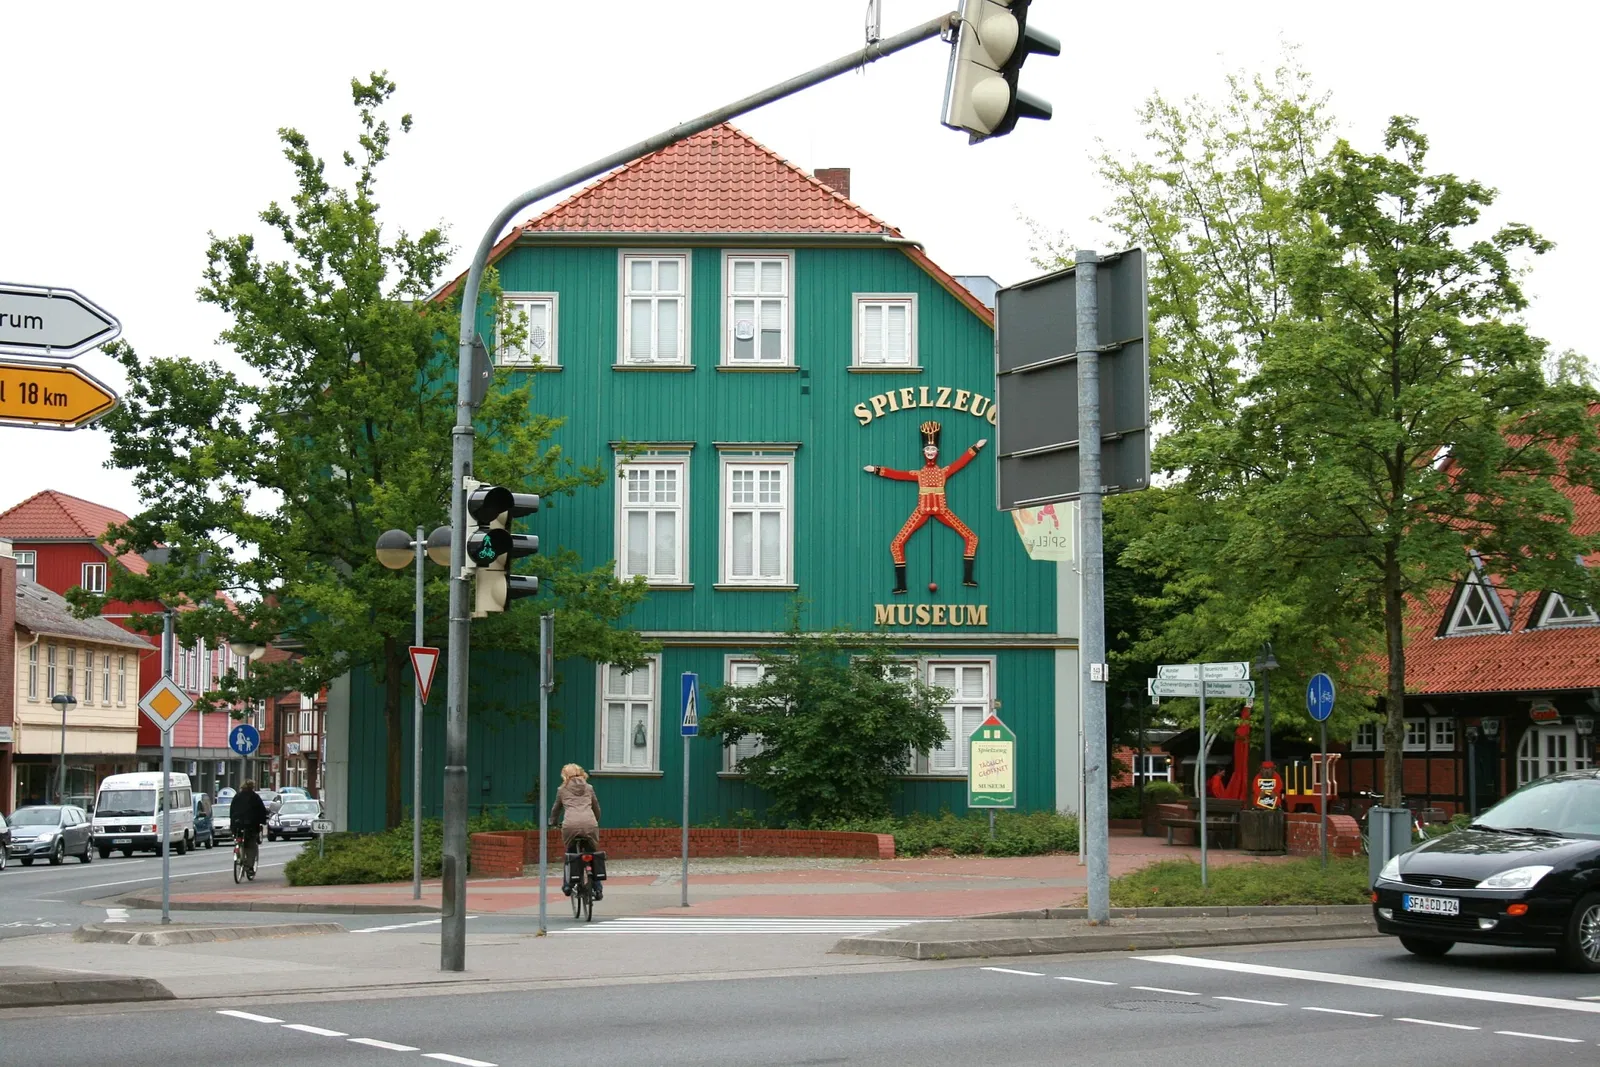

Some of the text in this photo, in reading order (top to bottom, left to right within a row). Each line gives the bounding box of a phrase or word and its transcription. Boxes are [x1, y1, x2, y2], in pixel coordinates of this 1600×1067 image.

[0, 313, 43, 330] rum
[19, 382, 38, 406] 18
[43, 387, 68, 408] km
[874, 603, 988, 626] MUSEUM
[1408, 896, 1458, 912] SFA CD 124
